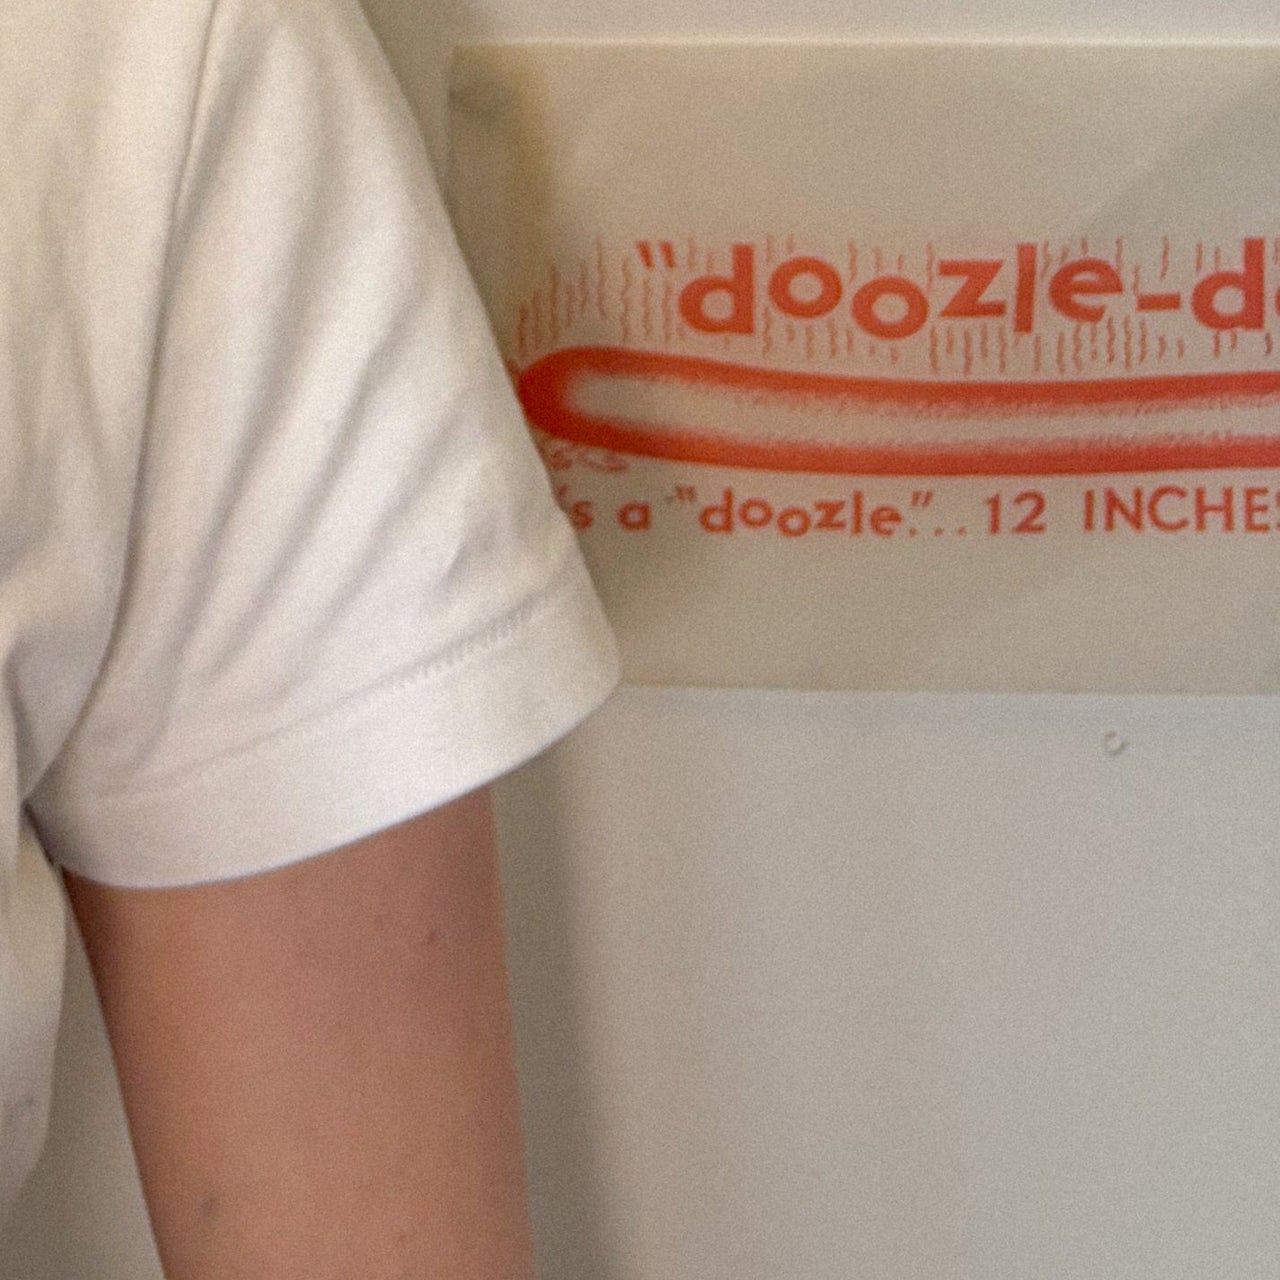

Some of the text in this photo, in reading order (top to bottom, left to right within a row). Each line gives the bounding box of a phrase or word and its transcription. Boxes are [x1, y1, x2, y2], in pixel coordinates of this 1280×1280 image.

[637, 237, 1280, 341] "doozle-d
[617, 502, 651, 532] a
[985, 490, 1046, 535] 12
[1083, 483, 1280, 534] INCHE
